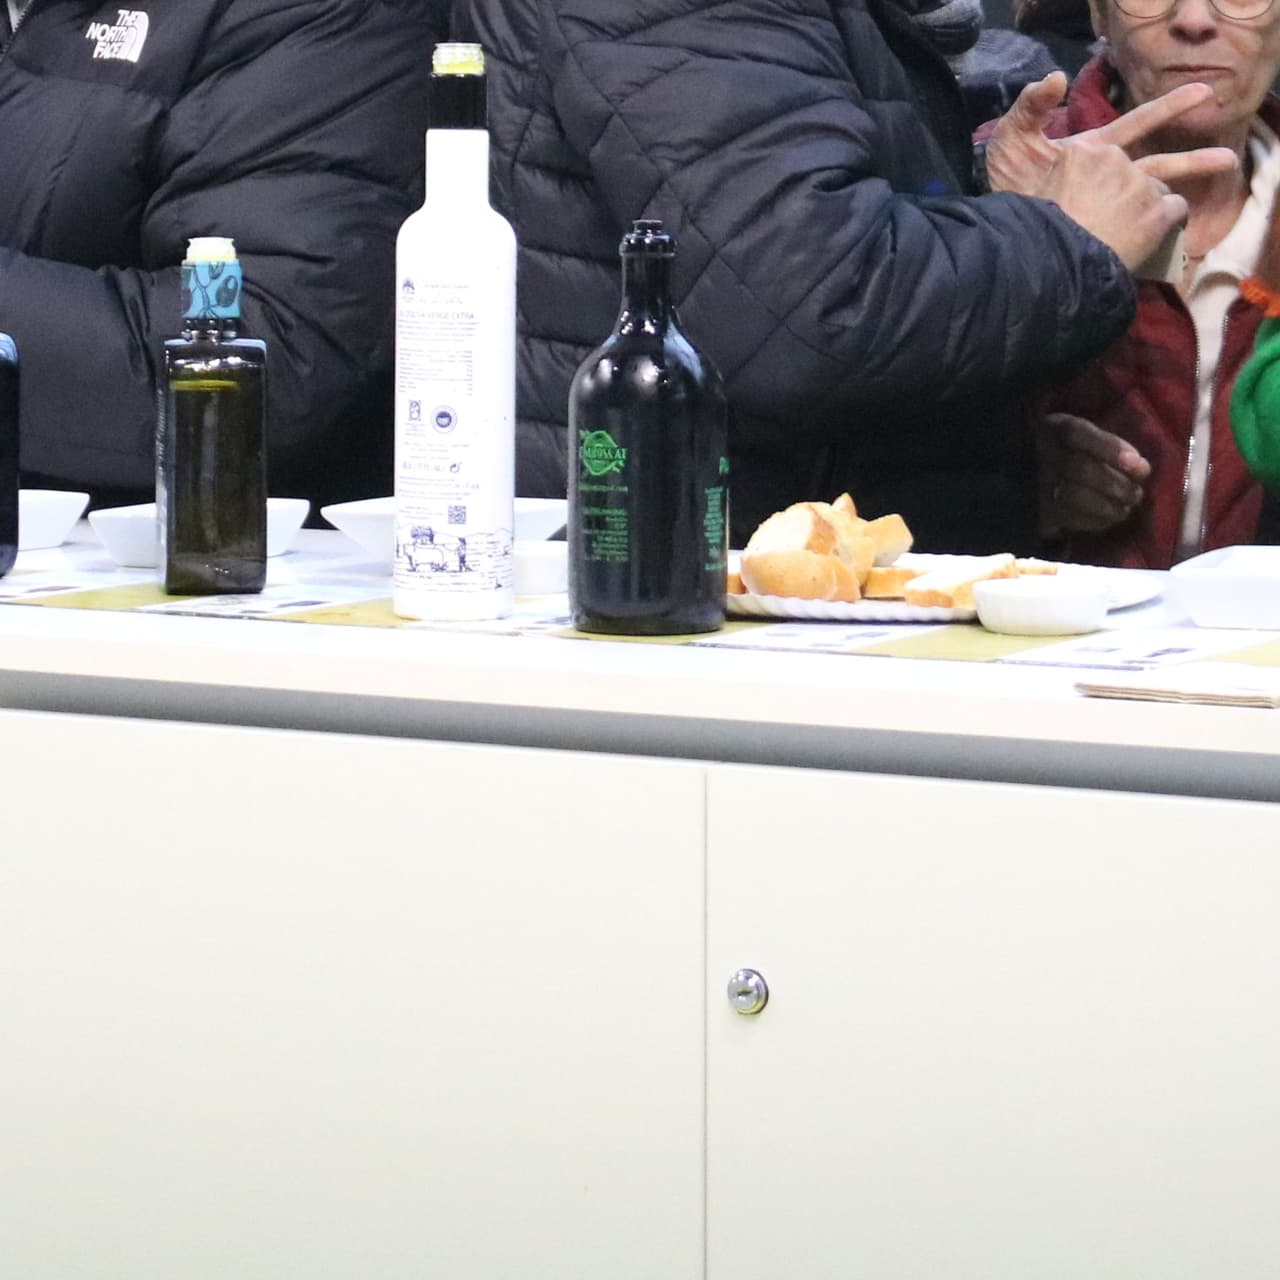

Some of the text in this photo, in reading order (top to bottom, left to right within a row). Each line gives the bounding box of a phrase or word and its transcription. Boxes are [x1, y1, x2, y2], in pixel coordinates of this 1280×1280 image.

[116, 9, 138, 26] THE
[85, 22, 129, 42] NORTH
[92, 41, 124, 59] FACE
